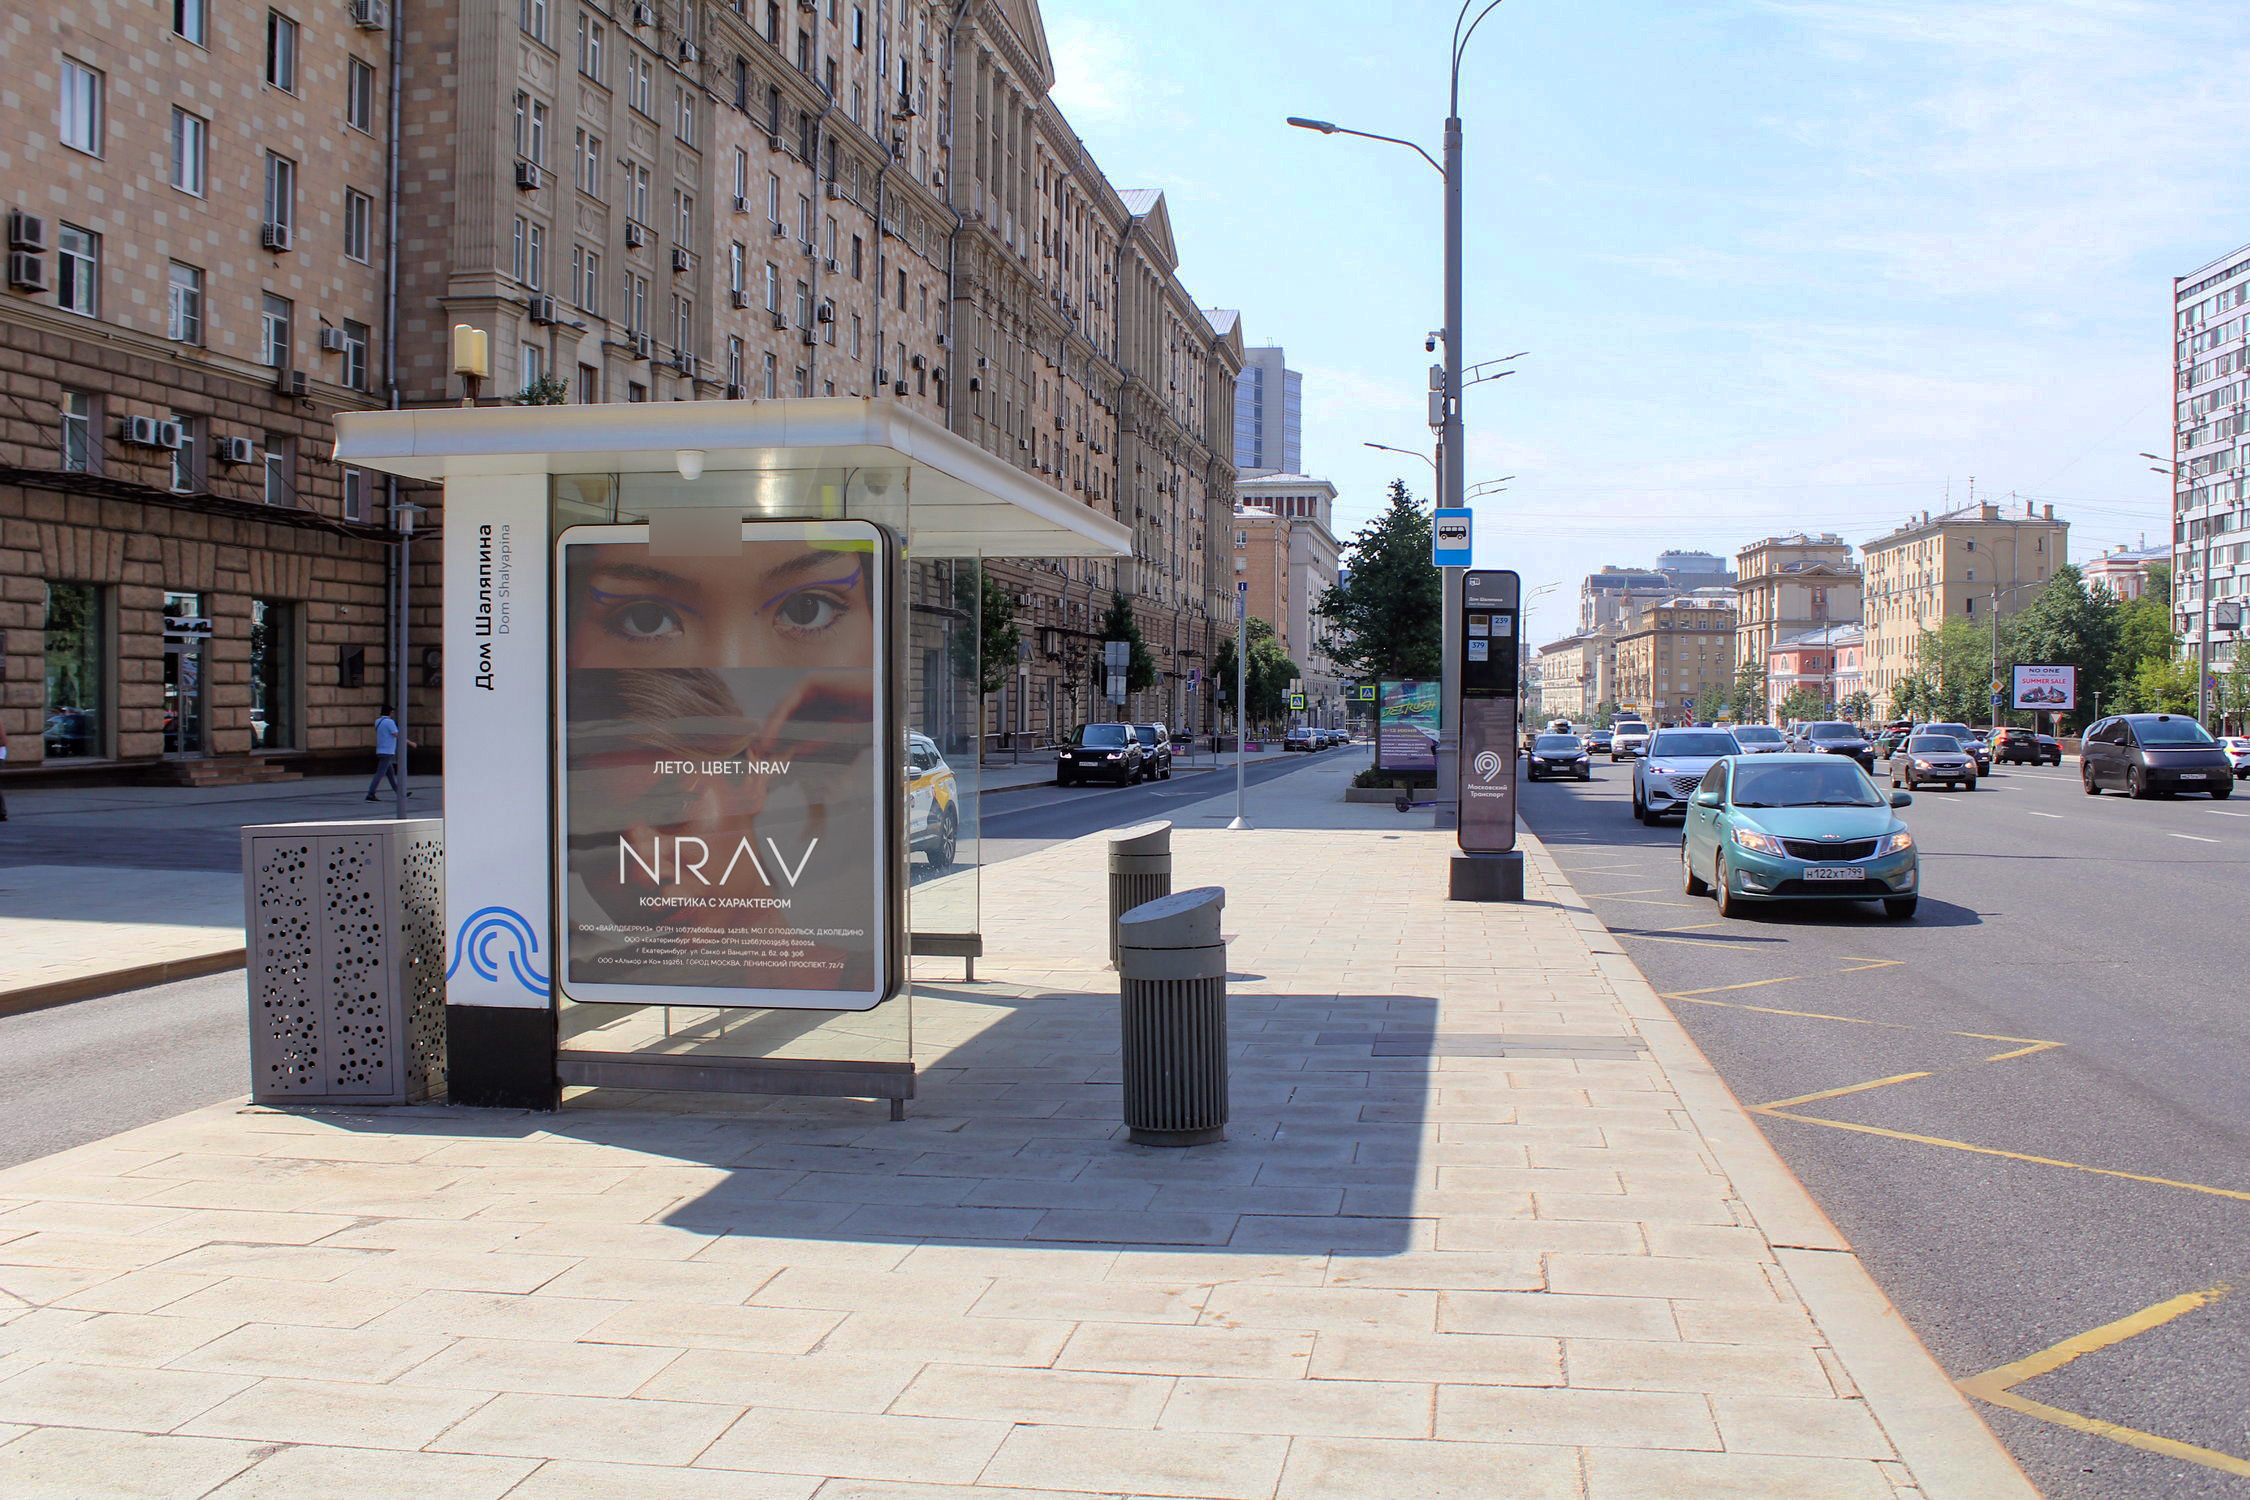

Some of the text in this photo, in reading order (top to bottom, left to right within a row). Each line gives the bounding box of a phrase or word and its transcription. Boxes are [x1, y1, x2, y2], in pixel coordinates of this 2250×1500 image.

[499, 524, 513, 635] Dom Shalyapina
[475, 524, 494, 691] Дом Шаляпина
[653, 761, 790, 776] ЛЕТО. ЦВЕТ. NRAV
[1467, 783, 1508, 791] Московский
[1470, 790, 1505, 799] Транспорт
[619, 834, 819, 888] NRAV
[639, 897, 791, 909] КОСМЕТИКА С ХАРАКТЕРОМ
[743, 959, 787, 967] ЛЕНИНСКИЙ
